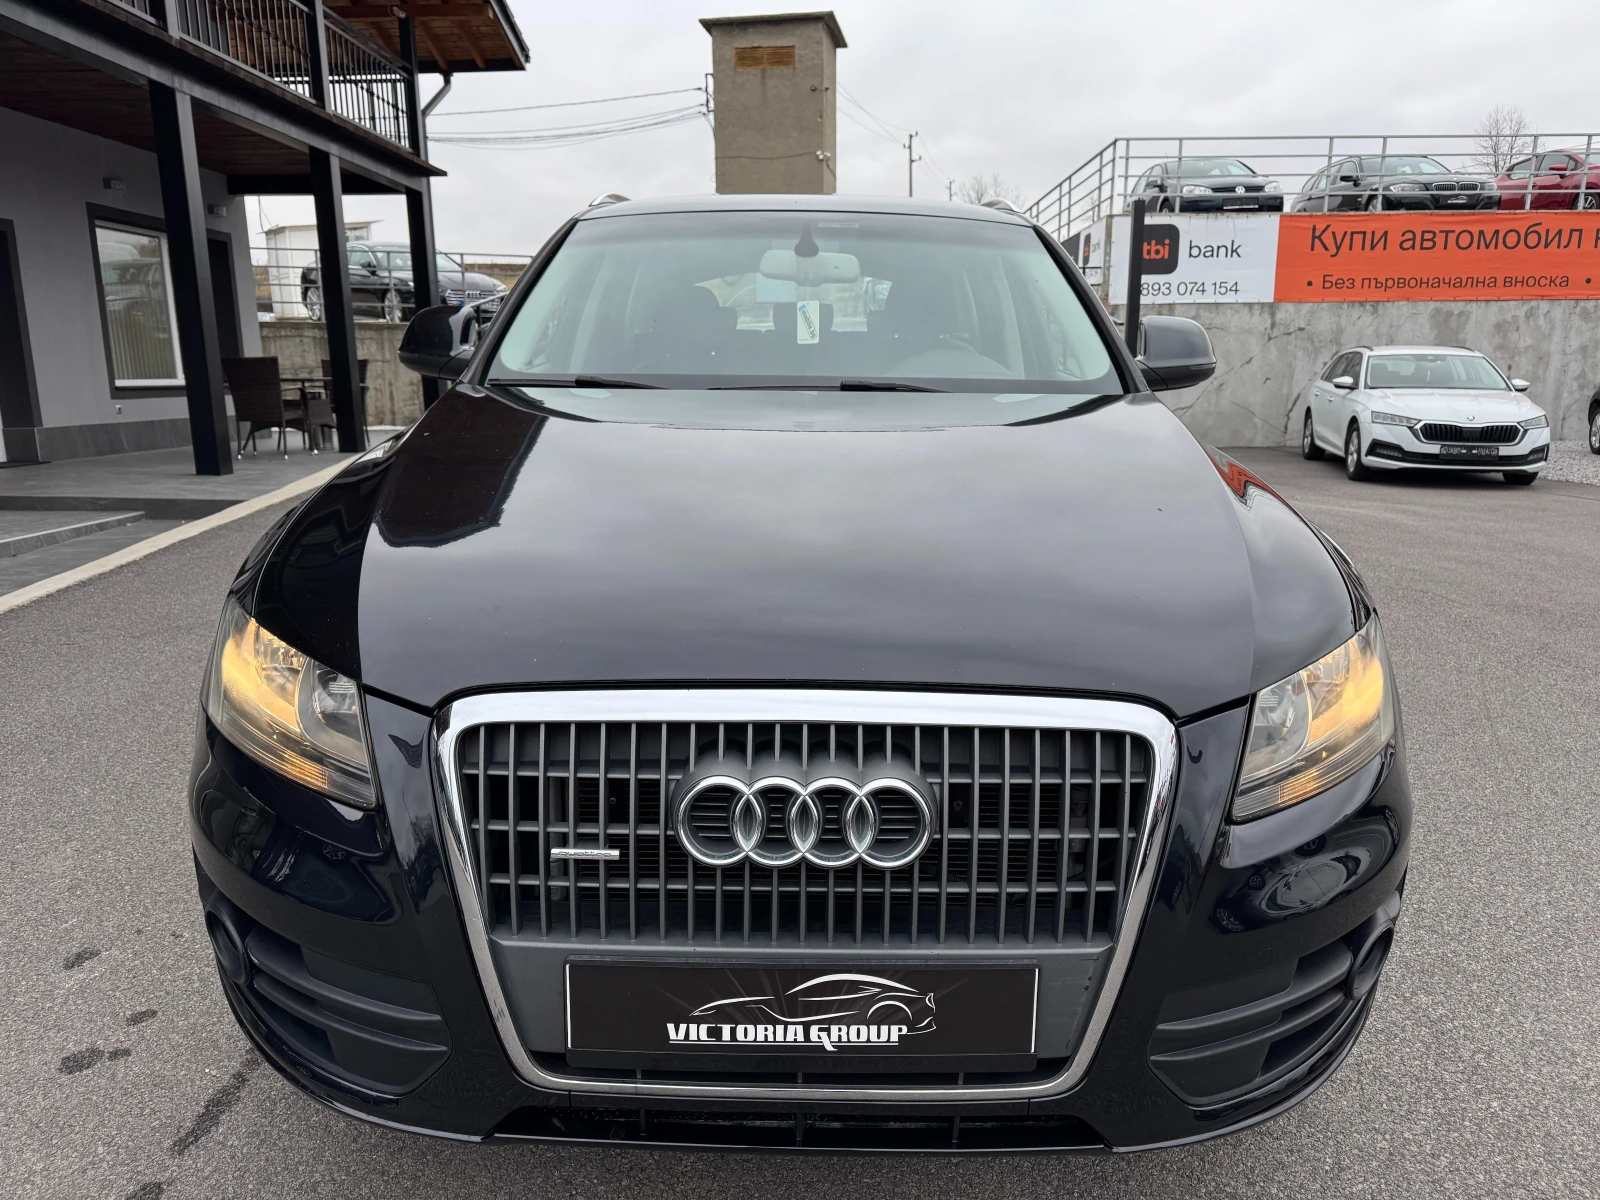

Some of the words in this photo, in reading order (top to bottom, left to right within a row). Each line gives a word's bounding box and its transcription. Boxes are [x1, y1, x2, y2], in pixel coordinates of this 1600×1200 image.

[1142, 239, 1170, 260] tbi
[1188, 240, 1242, 259] bank
[1310, 224, 1388, 258] Купи
[1399, 222, 1583, 251] автомобил
[1177, 281, 1207, 296] 074
[1211, 281, 1240, 296] 154
[1321, 274, 1356, 290] Без
[1361, 276, 1498, 292] първоначална
[1503, 275, 1569, 288] вноска
[667, 1023, 804, 1042] VICTORIA
[809, 1024, 908, 1051] GROUP
